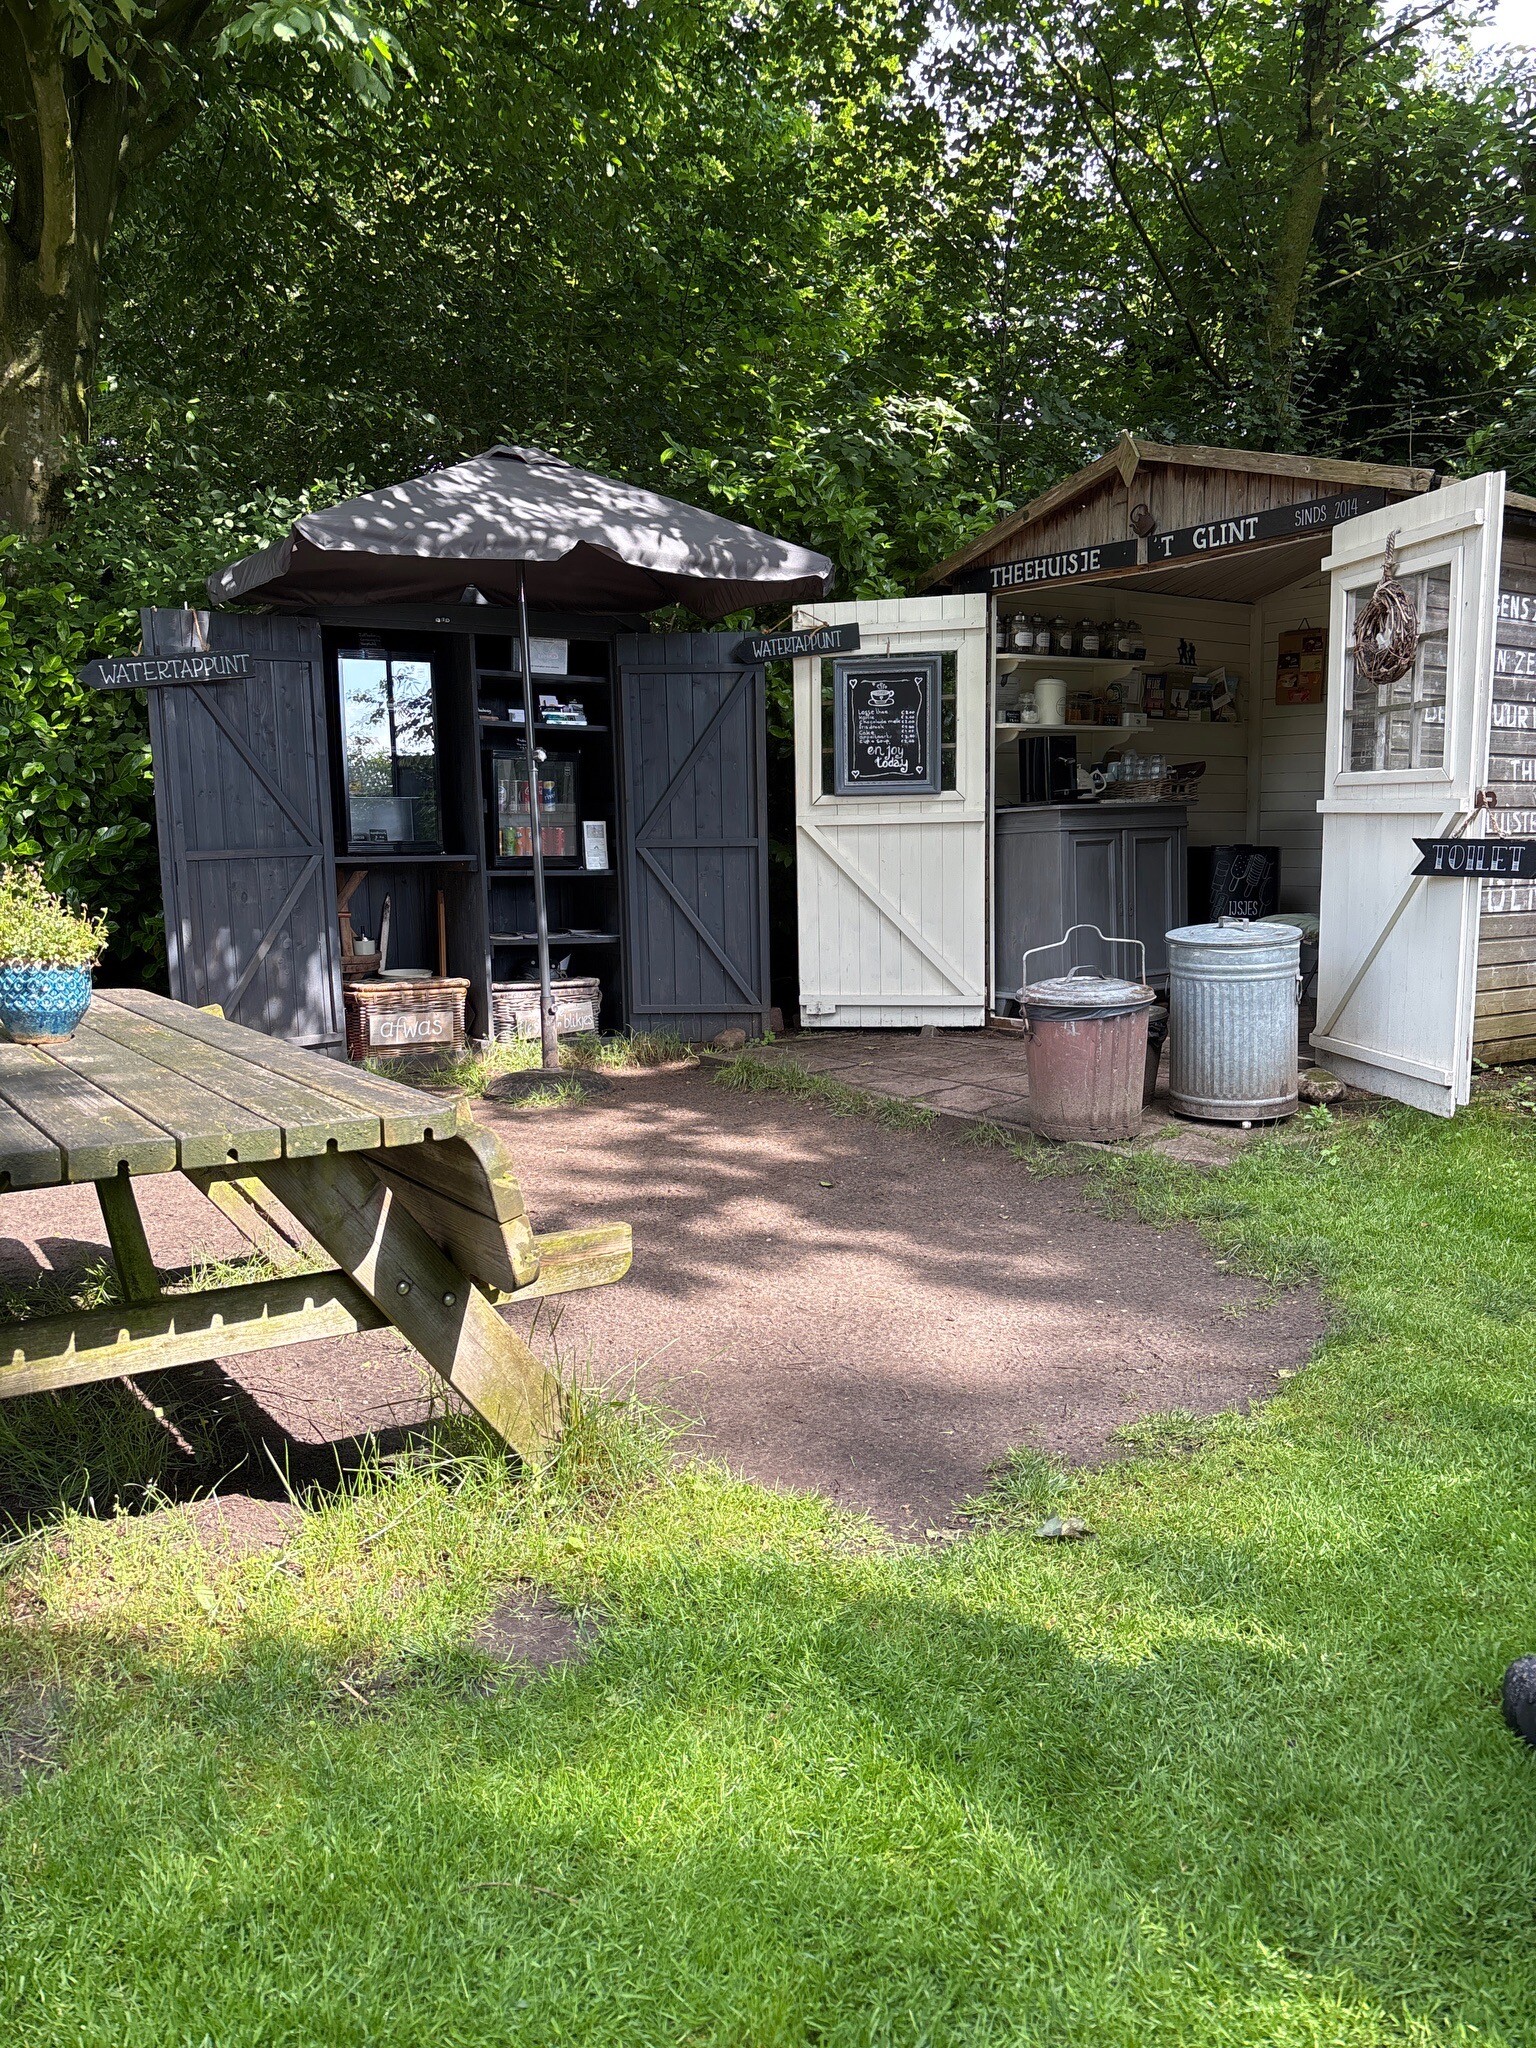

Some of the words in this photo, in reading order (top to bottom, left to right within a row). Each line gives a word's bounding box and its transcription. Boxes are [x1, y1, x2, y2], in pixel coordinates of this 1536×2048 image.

[990, 548, 1101, 588] THEEHUISJE
[1193, 516, 1259, 550] GLINT
[1294, 505, 1327, 528] SINDS
[1334, 498, 1359, 519] 2014
[752, 630, 842, 659] WATERTAPPUNT
[98, 654, 250, 685] WATERTAPPUNT
[874, 756, 909, 773] today
[1432, 843, 1526, 872] TOILET
[1228, 900, 1259, 916] IJSJES
[380, 1017, 443, 1043] afwas
